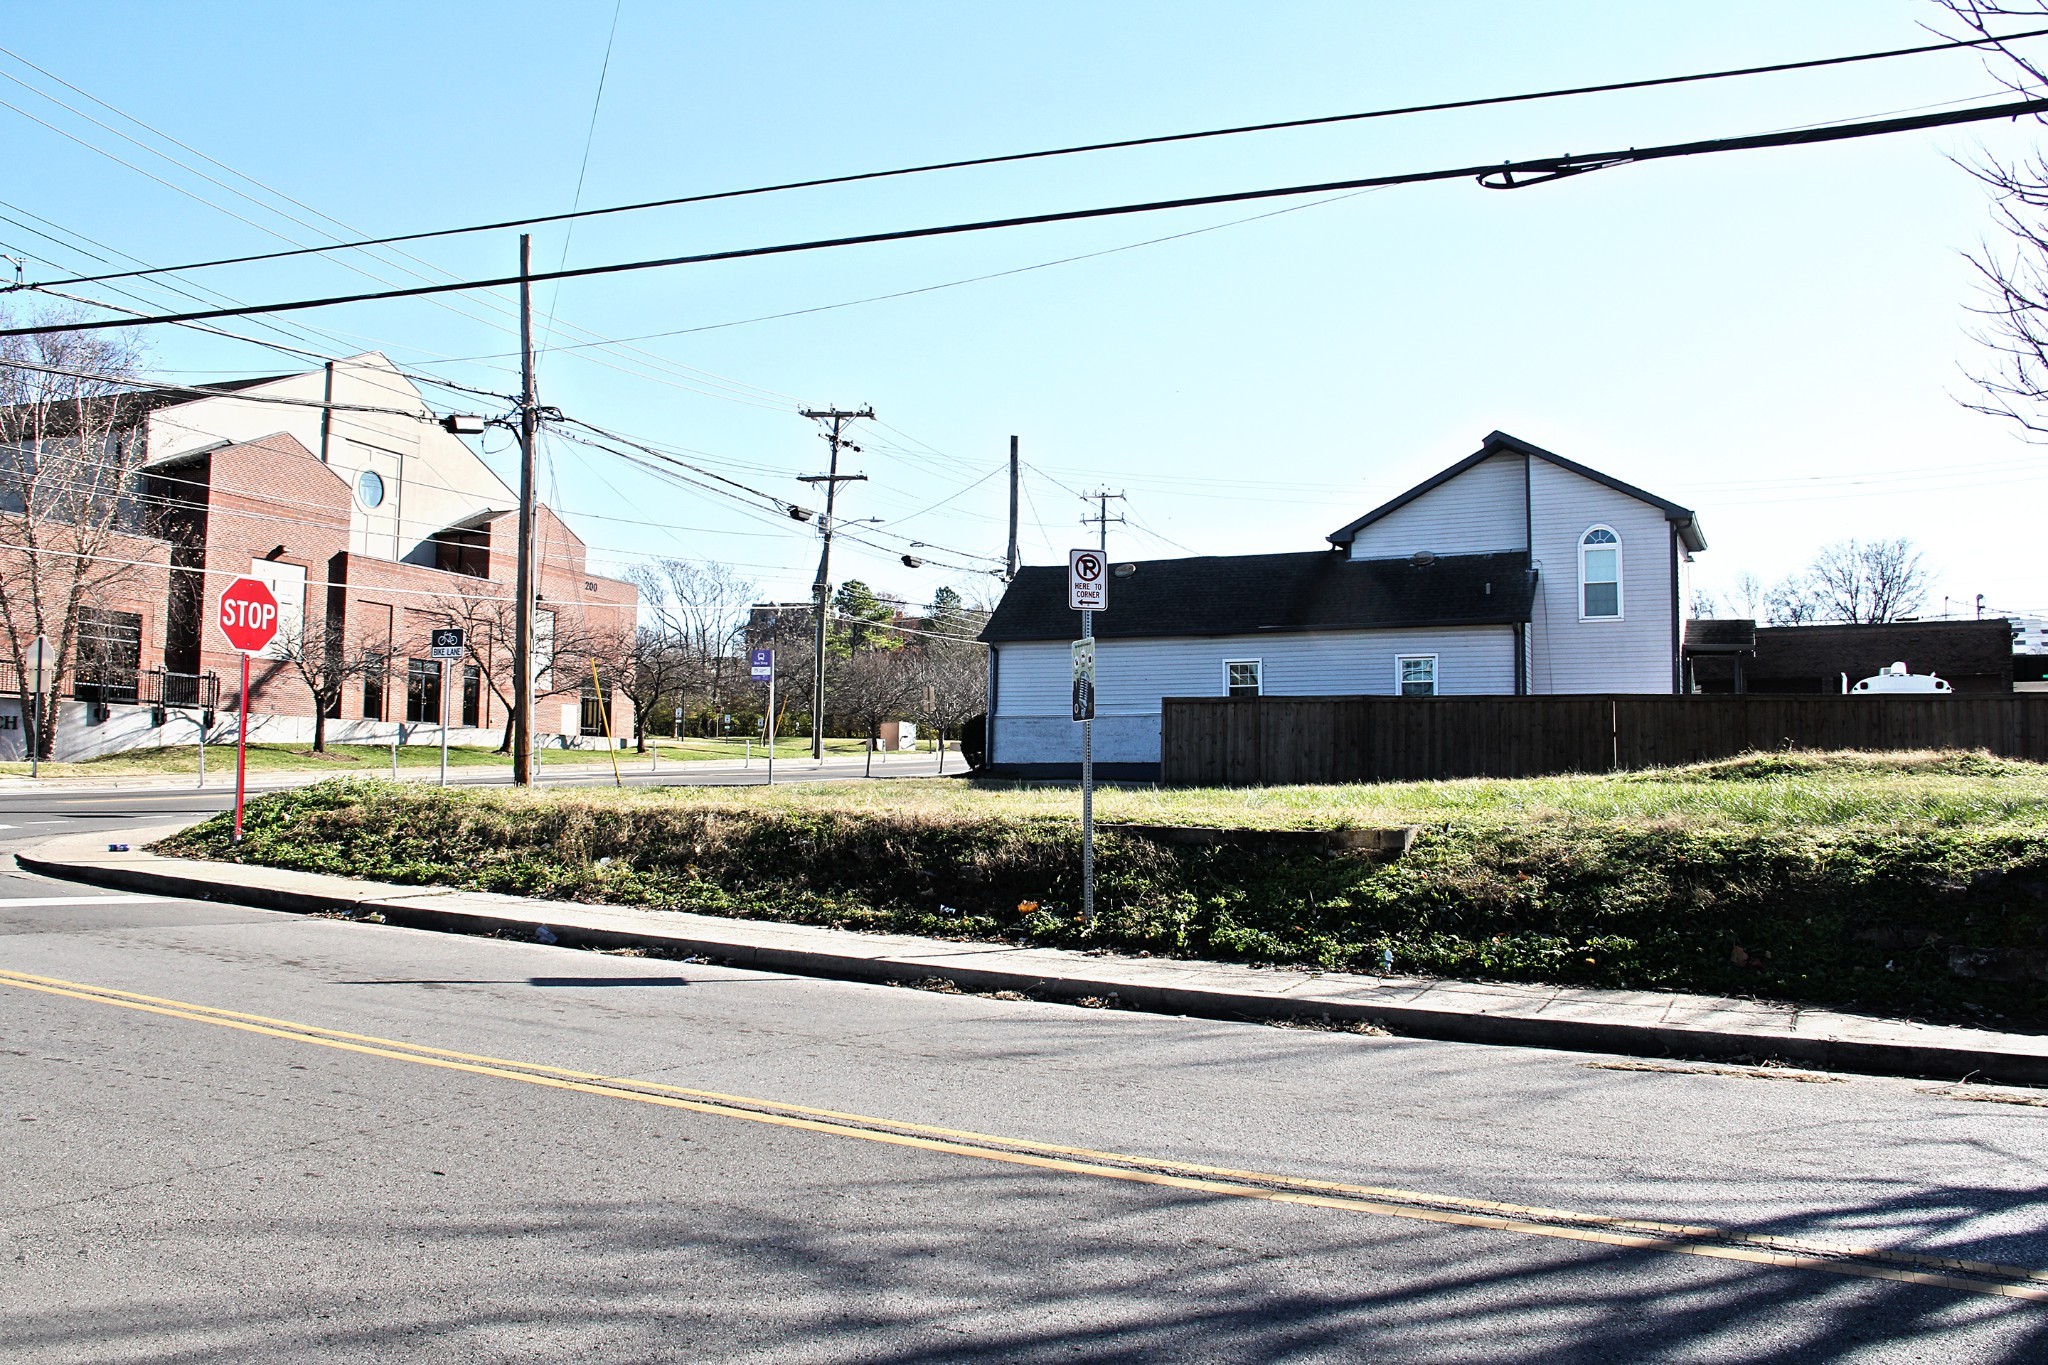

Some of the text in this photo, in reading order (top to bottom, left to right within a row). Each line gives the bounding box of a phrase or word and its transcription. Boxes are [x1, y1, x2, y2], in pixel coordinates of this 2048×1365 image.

[584, 581, 598, 592] 200
[1074, 582, 1102, 591] HERE TO
[1076, 590, 1100, 598] CORNER
[222, 598, 276, 630] STOP
[434, 648, 461, 656] BIKE LANE
